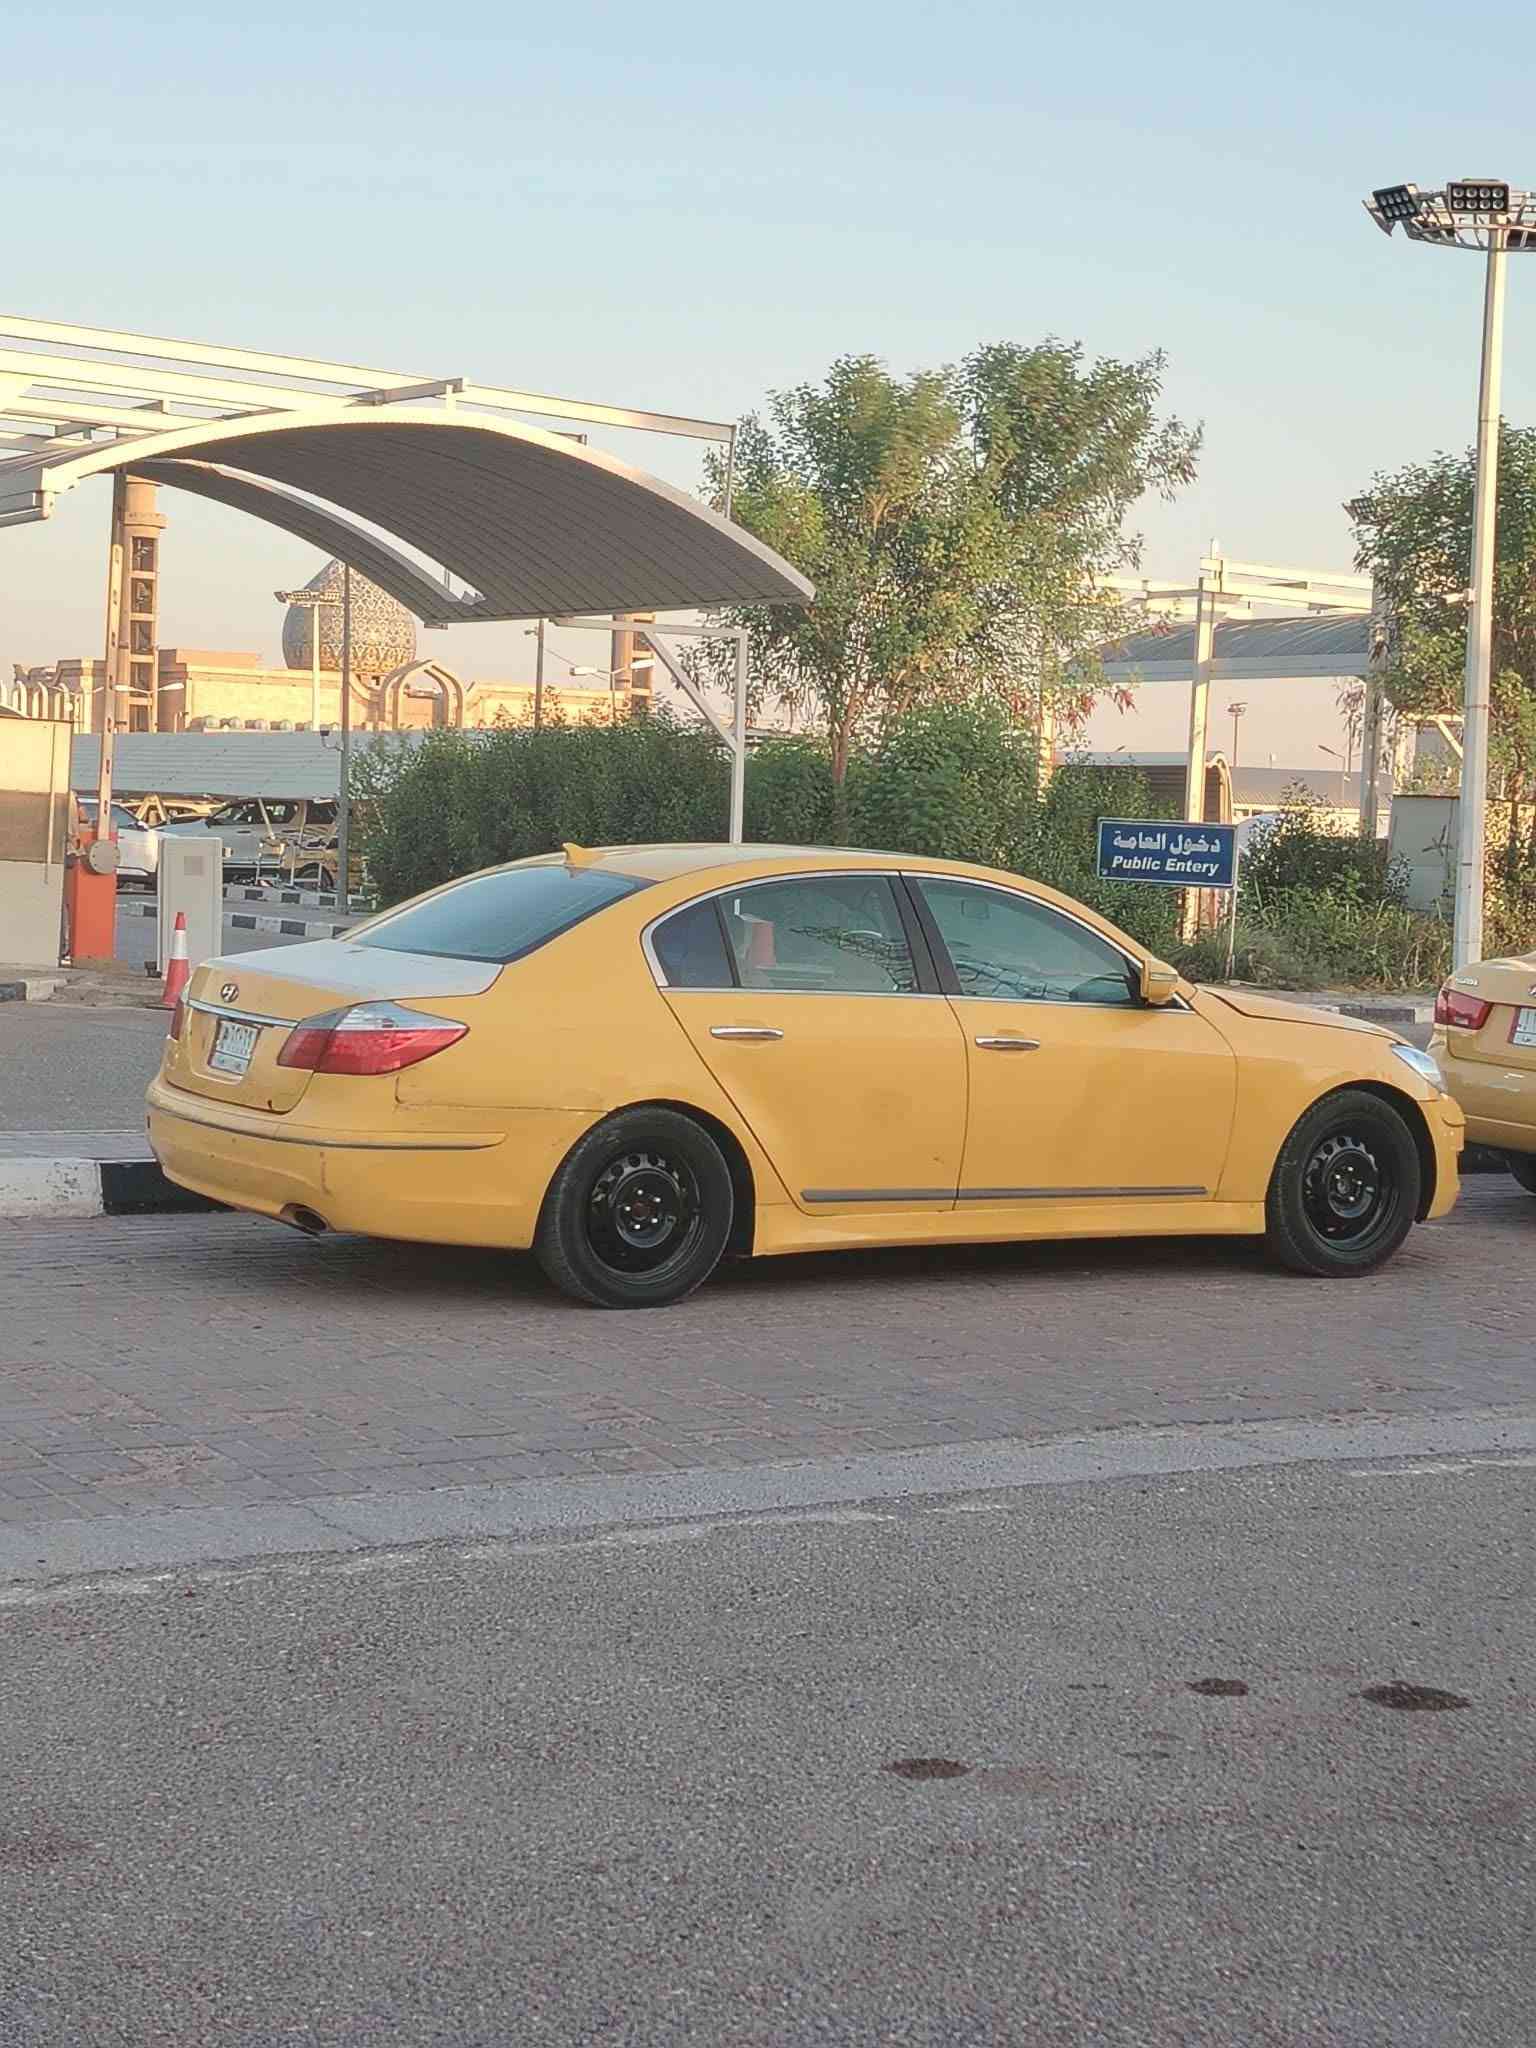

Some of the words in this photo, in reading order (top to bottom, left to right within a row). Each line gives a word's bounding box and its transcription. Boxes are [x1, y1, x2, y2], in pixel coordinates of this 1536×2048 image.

[1113, 830, 1167, 851] العامة
[1170, 834, 1221, 855] دخول
[1112, 855, 1161, 871] Public
[1165, 858, 1220, 877] Entery
